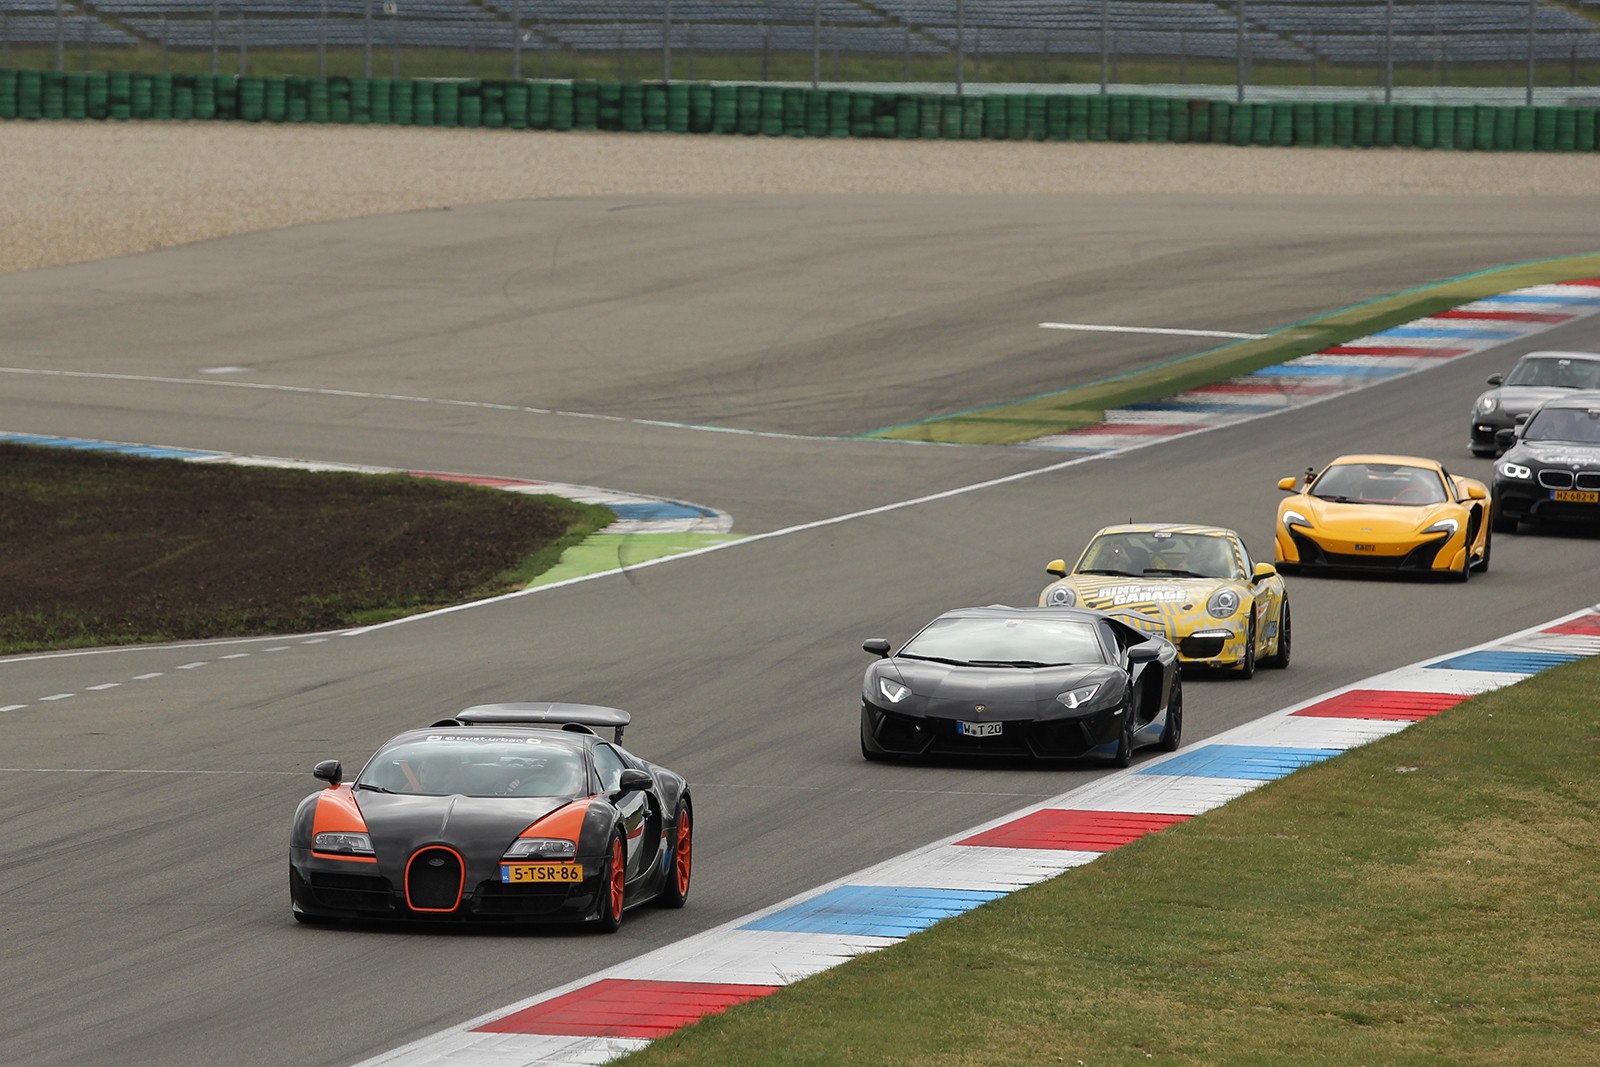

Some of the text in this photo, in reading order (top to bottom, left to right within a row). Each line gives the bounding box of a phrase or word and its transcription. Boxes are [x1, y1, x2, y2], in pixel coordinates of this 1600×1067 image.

[1113, 590, 1187, 606] GARAGE
[444, 735, 524, 743] @trust.urban
[514, 867, 578, 880] 5-TSR-86
